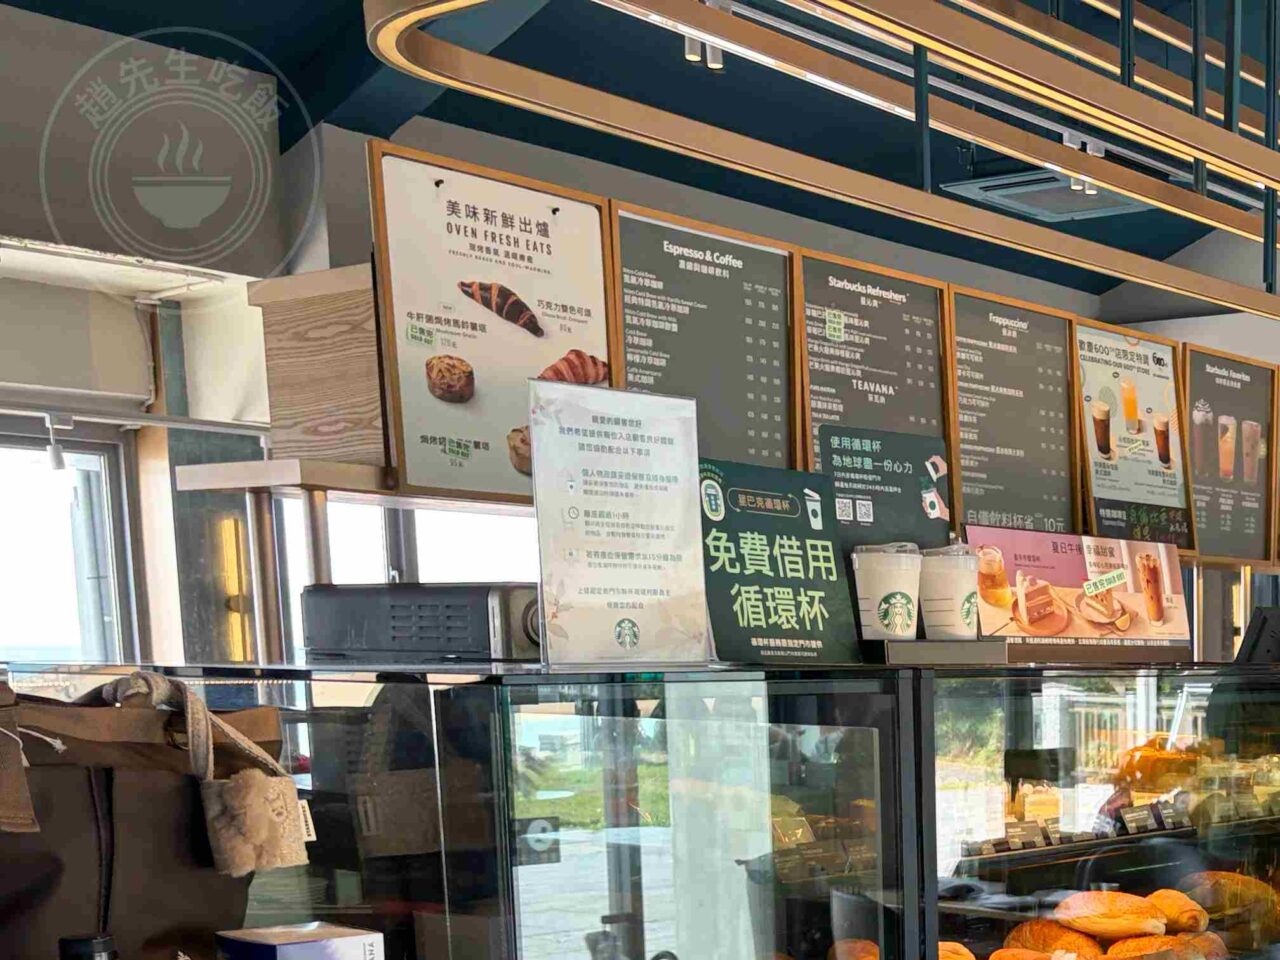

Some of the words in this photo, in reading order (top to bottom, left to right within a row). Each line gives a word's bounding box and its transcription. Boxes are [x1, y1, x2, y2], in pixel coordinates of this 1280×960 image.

[446, 200, 550, 238] 美味新鮮出爐
[446, 222, 478, 240] OVEN
[484, 231, 520, 249] FRESH
[526, 239, 552, 256] EATS
[663, 240, 704, 261] Espresso
[704, 250, 713, 262] &
[713, 252, 743, 269] Coffee
[828, 276, 867, 294] Starbucks
[867, 284, 907, 303] Refreshers
[989, 312, 1029, 330] Frappuccino
[410, 324, 434, 338] 已售完
[852, 379, 895, 396] TEAVANA
[830, 436, 882, 453] 使用循環杯
[832, 454, 913, 474] 為地球盡一份心力
[738, 493, 791, 512] 星巴克循環杯
[1043, 517, 1065, 532] 10元
[705, 528, 837, 581] 免費借用
[1052, 541, 1083, 556] 夏日午後
[1085, 578, 1105, 593] 已售完
[730, 583, 829, 632] 循環杯
